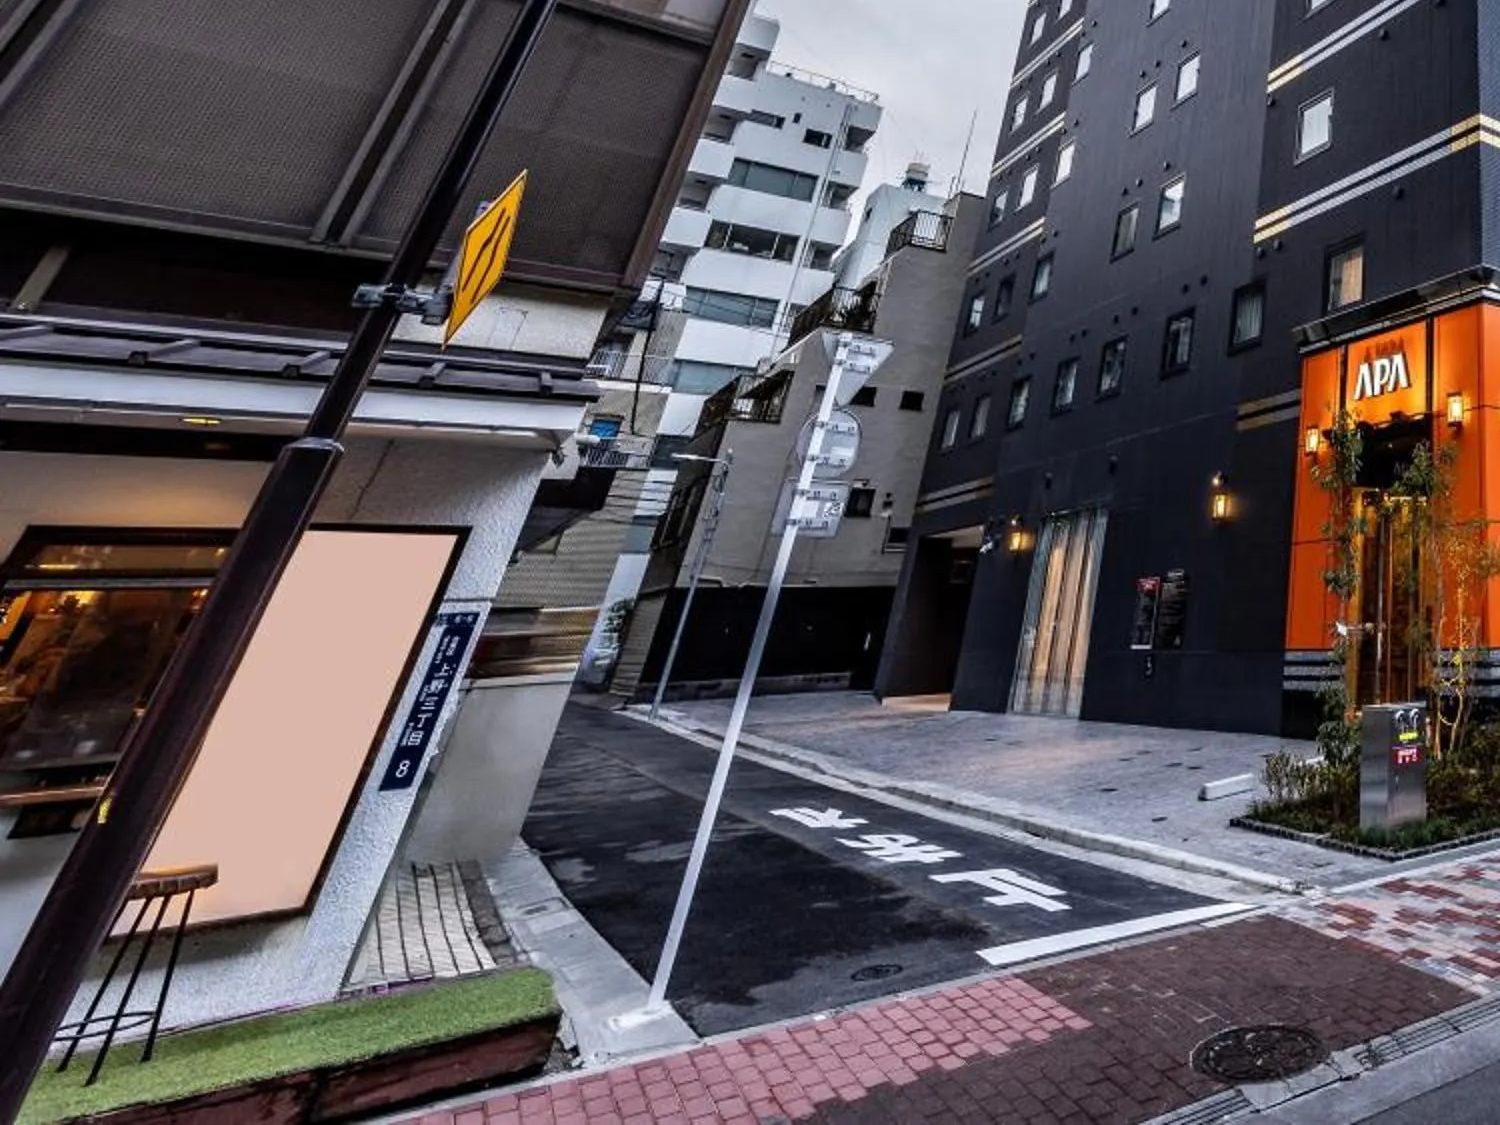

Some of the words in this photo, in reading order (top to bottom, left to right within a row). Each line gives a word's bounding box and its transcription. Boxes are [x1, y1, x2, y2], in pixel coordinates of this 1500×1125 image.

[1353, 351, 1409, 400] APA
[396, 760, 411, 778] 8
[769, 807, 1073, 912] 止まれ
